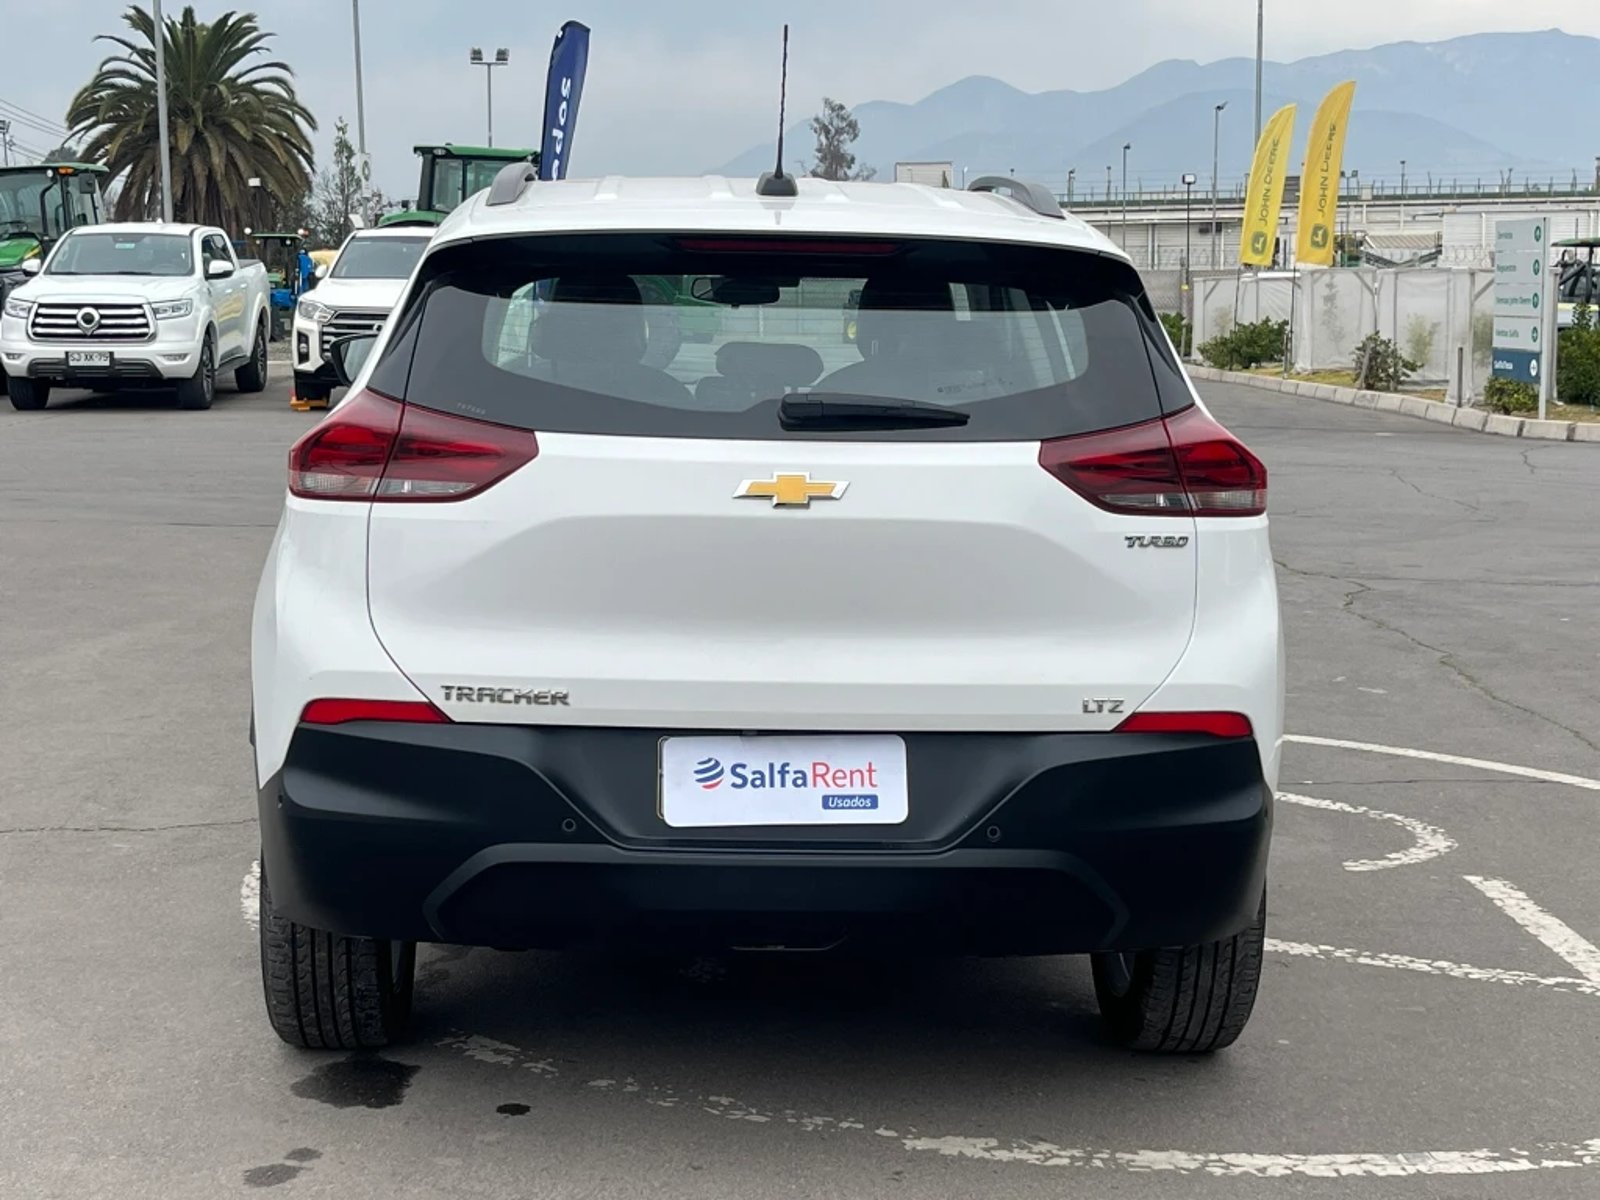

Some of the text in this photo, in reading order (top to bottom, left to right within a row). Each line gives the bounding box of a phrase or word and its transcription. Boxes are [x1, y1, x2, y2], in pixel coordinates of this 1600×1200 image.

[1258, 188, 1271, 226] JOHN
[1317, 176, 1329, 217] JOHN
[1124, 535, 1189, 548] TURBO
[441, 685, 570, 706] TRACKER
[1082, 698, 1124, 714] LTZ
[730, 761, 878, 789] SalfaRent
[828, 796, 872, 808] Usados
